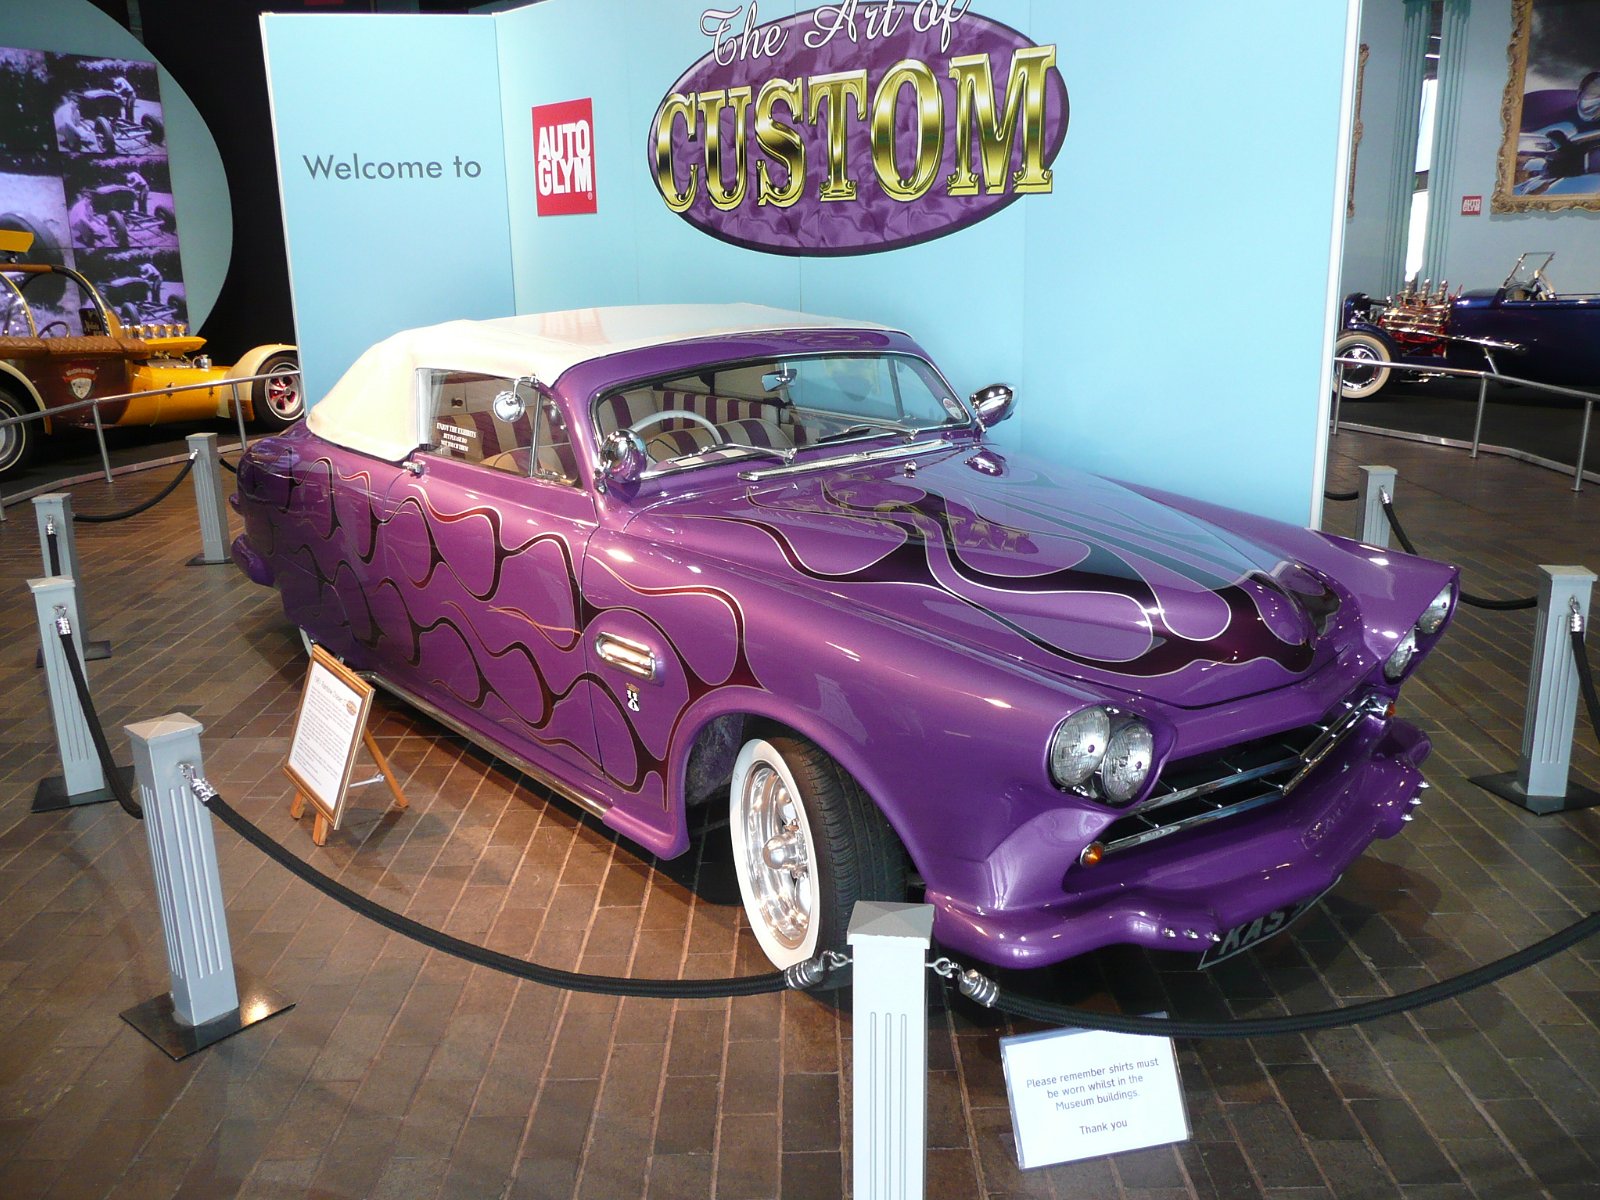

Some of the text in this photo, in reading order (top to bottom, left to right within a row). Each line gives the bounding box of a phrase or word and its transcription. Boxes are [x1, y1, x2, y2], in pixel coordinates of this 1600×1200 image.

[699, 0, 971, 66] The Art of
[538, 119, 591, 162] AUTO
[655, 44, 1057, 213] CUSTOM
[302, 153, 482, 180] Welcome to
[538, 156, 593, 197] GLYM
[1026, 1057, 1160, 1089] Please remember shirts must
[1047, 1074, 1144, 1099] be worn whilst in the
[1055, 1098, 1095, 1111] Museum
[1079, 1119, 1128, 1135] Thank you
